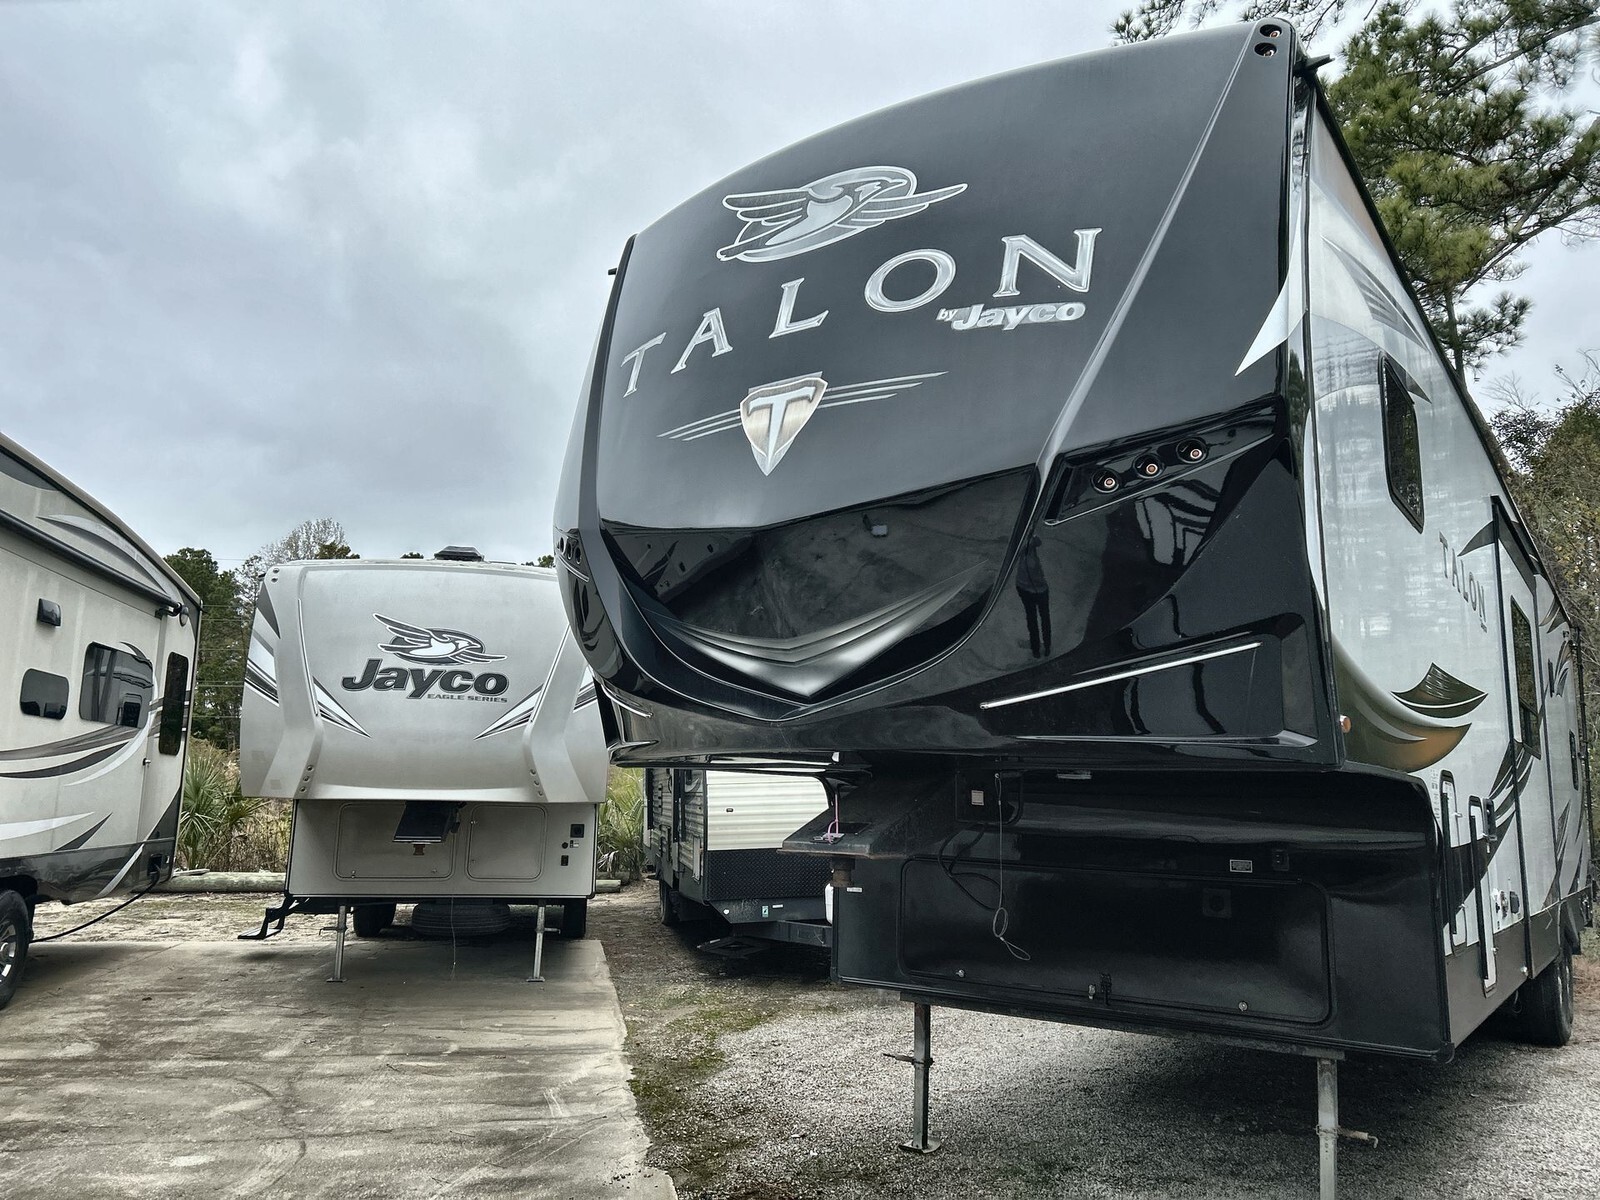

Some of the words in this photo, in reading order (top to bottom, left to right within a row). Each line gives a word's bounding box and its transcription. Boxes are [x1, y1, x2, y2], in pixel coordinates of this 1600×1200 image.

[621, 227, 1102, 398] TALON
[936, 308, 958, 322] by
[951, 302, 1086, 331] Jayco
[1438, 531, 1487, 622] TALON
[341, 658, 509, 699] Jayco
[427, 693, 465, 701] EAGLE
[467, 695, 508, 703] SERIES
